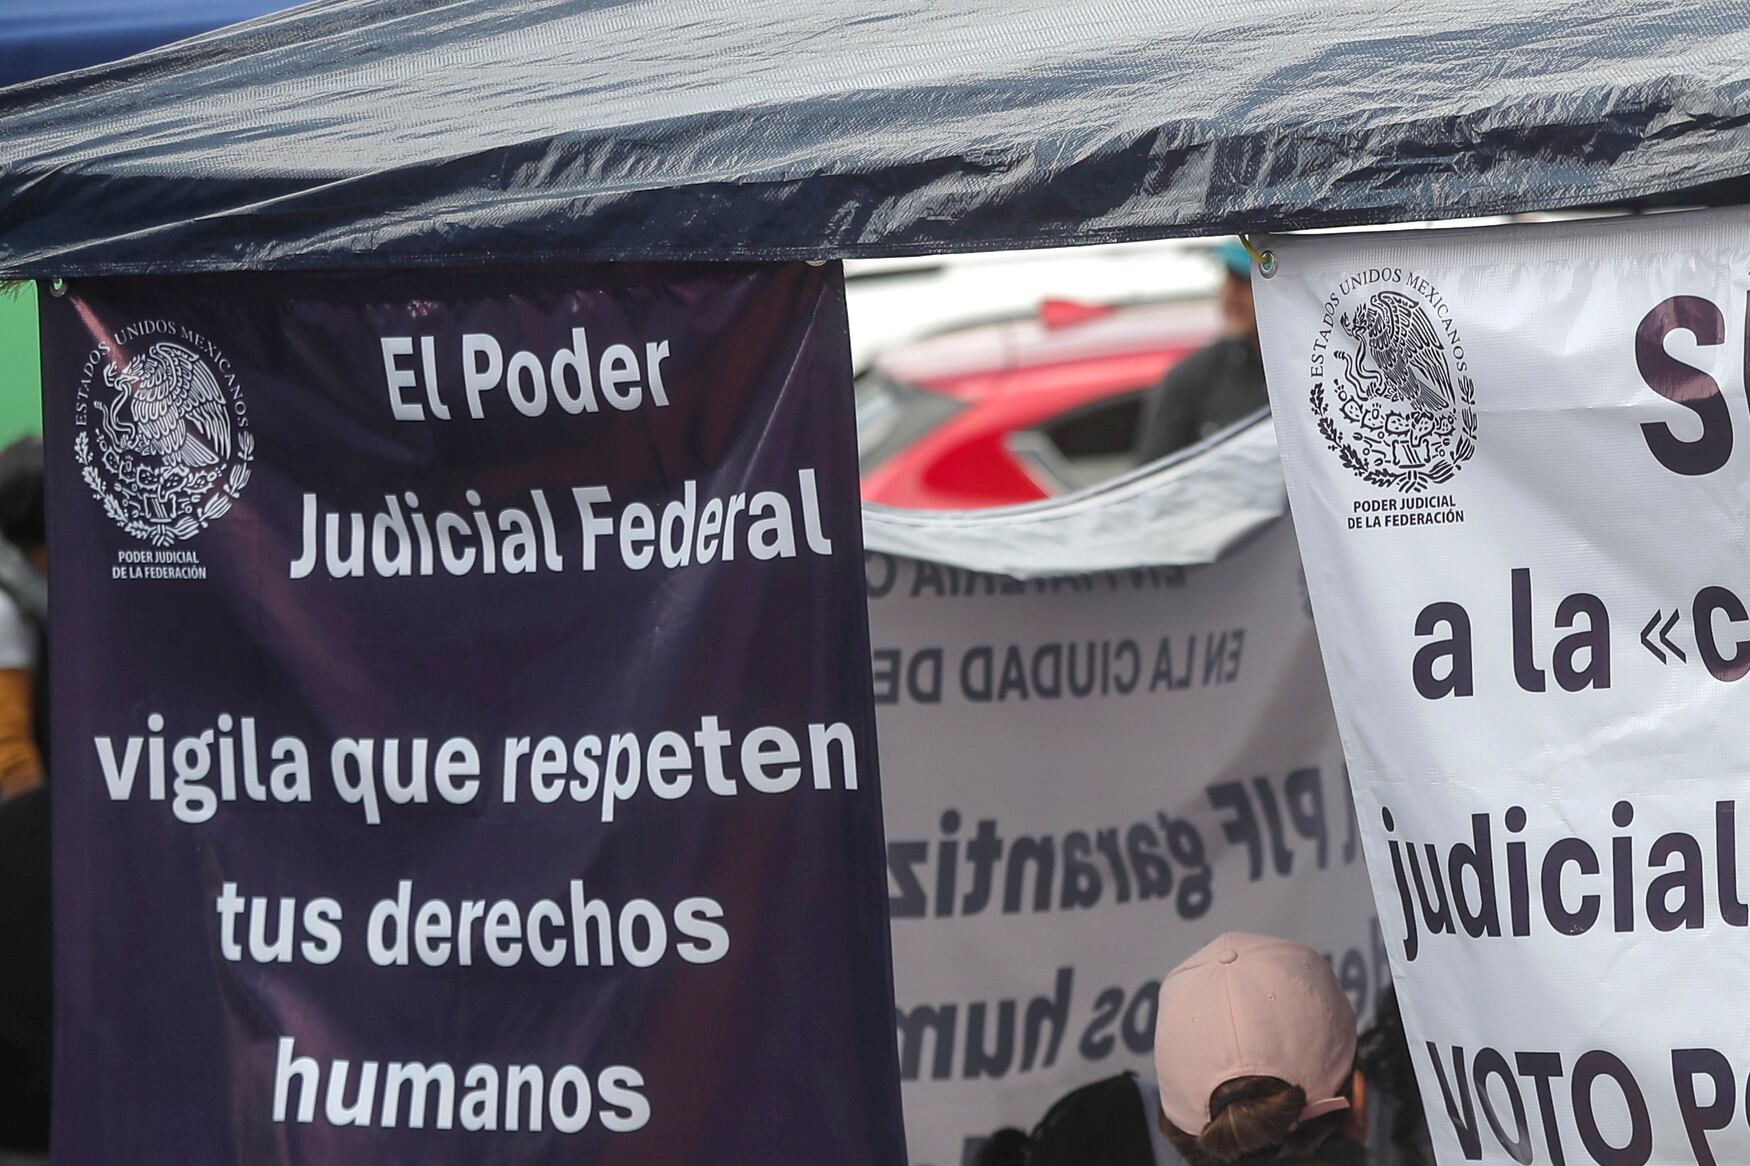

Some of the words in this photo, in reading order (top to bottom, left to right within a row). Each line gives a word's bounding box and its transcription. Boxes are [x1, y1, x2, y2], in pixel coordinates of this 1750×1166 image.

[1311, 293, 1340, 378] ESTADOS
[1340, 267, 1402, 296] UNIDOS
[1407, 272, 1467, 373] MEXICANOS
[75, 341, 111, 426] ESTADOS
[114, 319, 177, 346] UNIDOS
[181, 326, 249, 427] MEXICANOS
[381, 336, 449, 421] El
[468, 327, 670, 419] Poder
[290, 489, 563, 579] Judicial
[573, 468, 832, 570] Federal
[1347, 517, 1363, 529] DE
[1366, 516, 1381, 528] LA
[1385, 509, 1464, 527] FEDERACIÓN
[1353, 499, 1397, 513] PODER
[1400, 495, 1456, 510] JUDICIAL
[112, 567, 128, 579] DE
[129, 567, 143, 579] LA
[145, 565, 206, 579] FEDERACIÓN
[118, 551, 153, 563] PODER
[155, 551, 199, 563] JUDICIAL
[1412, 601, 1474, 700] a
[1510, 568, 1611, 693] la
[94, 713, 311, 823] vigila
[330, 737, 467, 824] que
[503, 715, 858, 822] respeten
[216, 883, 342, 964] tus
[367, 880, 730, 967] derechos
[273, 1038, 651, 1132] humanos
